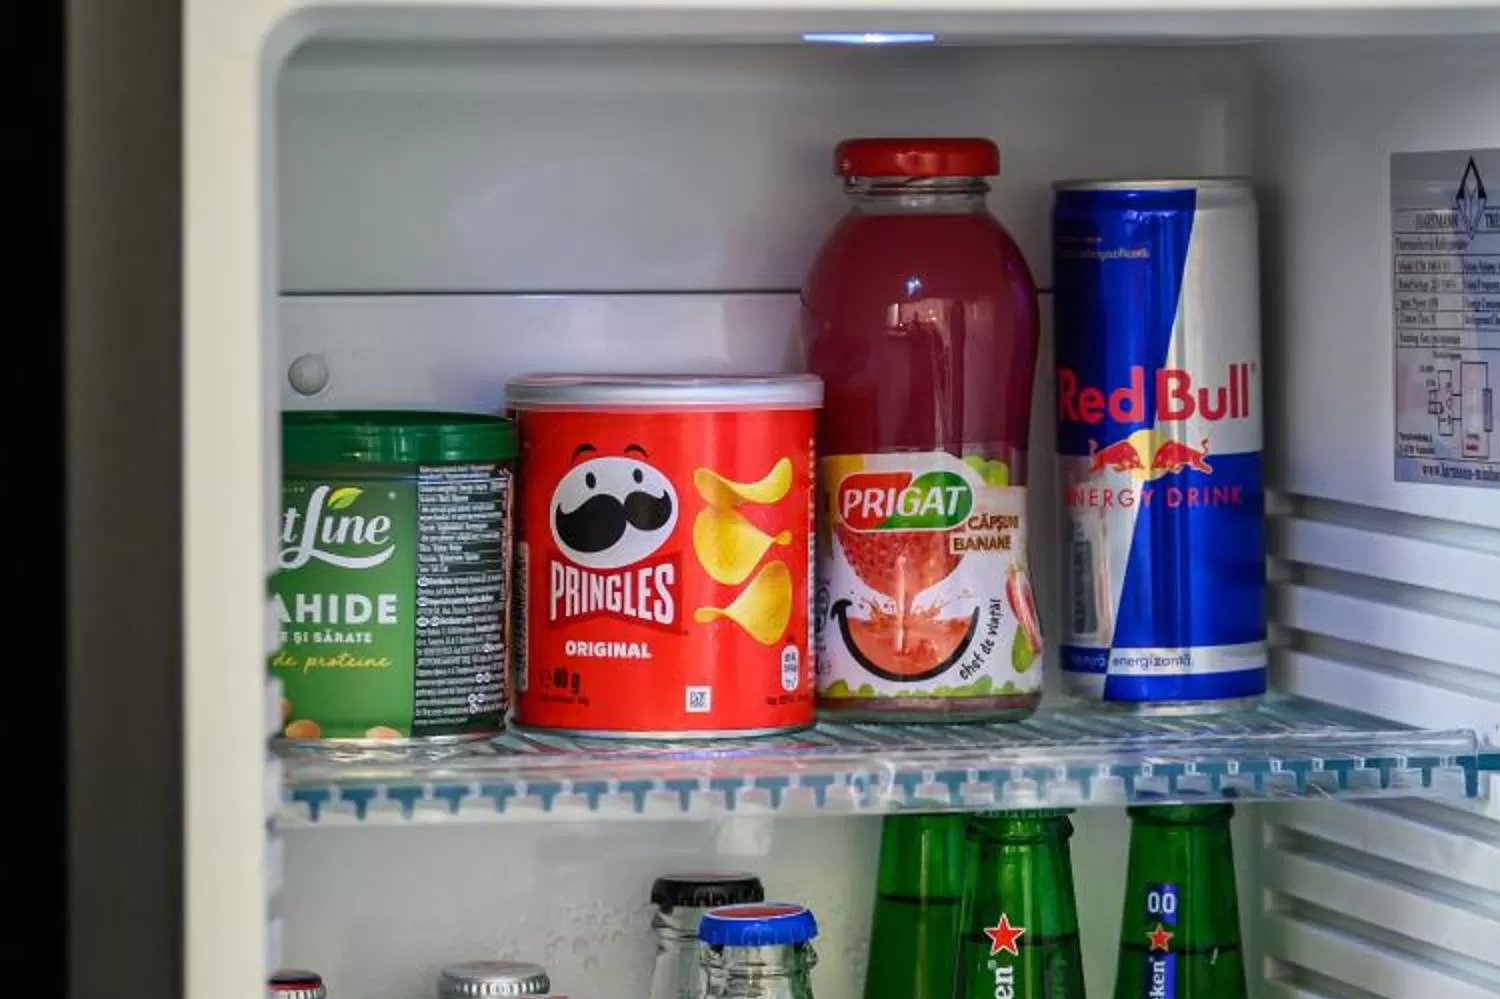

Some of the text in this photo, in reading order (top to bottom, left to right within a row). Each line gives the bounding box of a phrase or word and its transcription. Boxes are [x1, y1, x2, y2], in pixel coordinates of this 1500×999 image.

[1059, 363, 1249, 424] Red Bull
[843, 486, 968, 519] PRIGAT
[1064, 485, 1242, 508] ENERGY DRINK
[953, 534, 1011, 551] BANANE
[550, 559, 675, 626] PRINGLES
[273, 593, 398, 625] AHIDE
[565, 639, 653, 659] ORIGINAL
[980, 638, 995, 655] de
